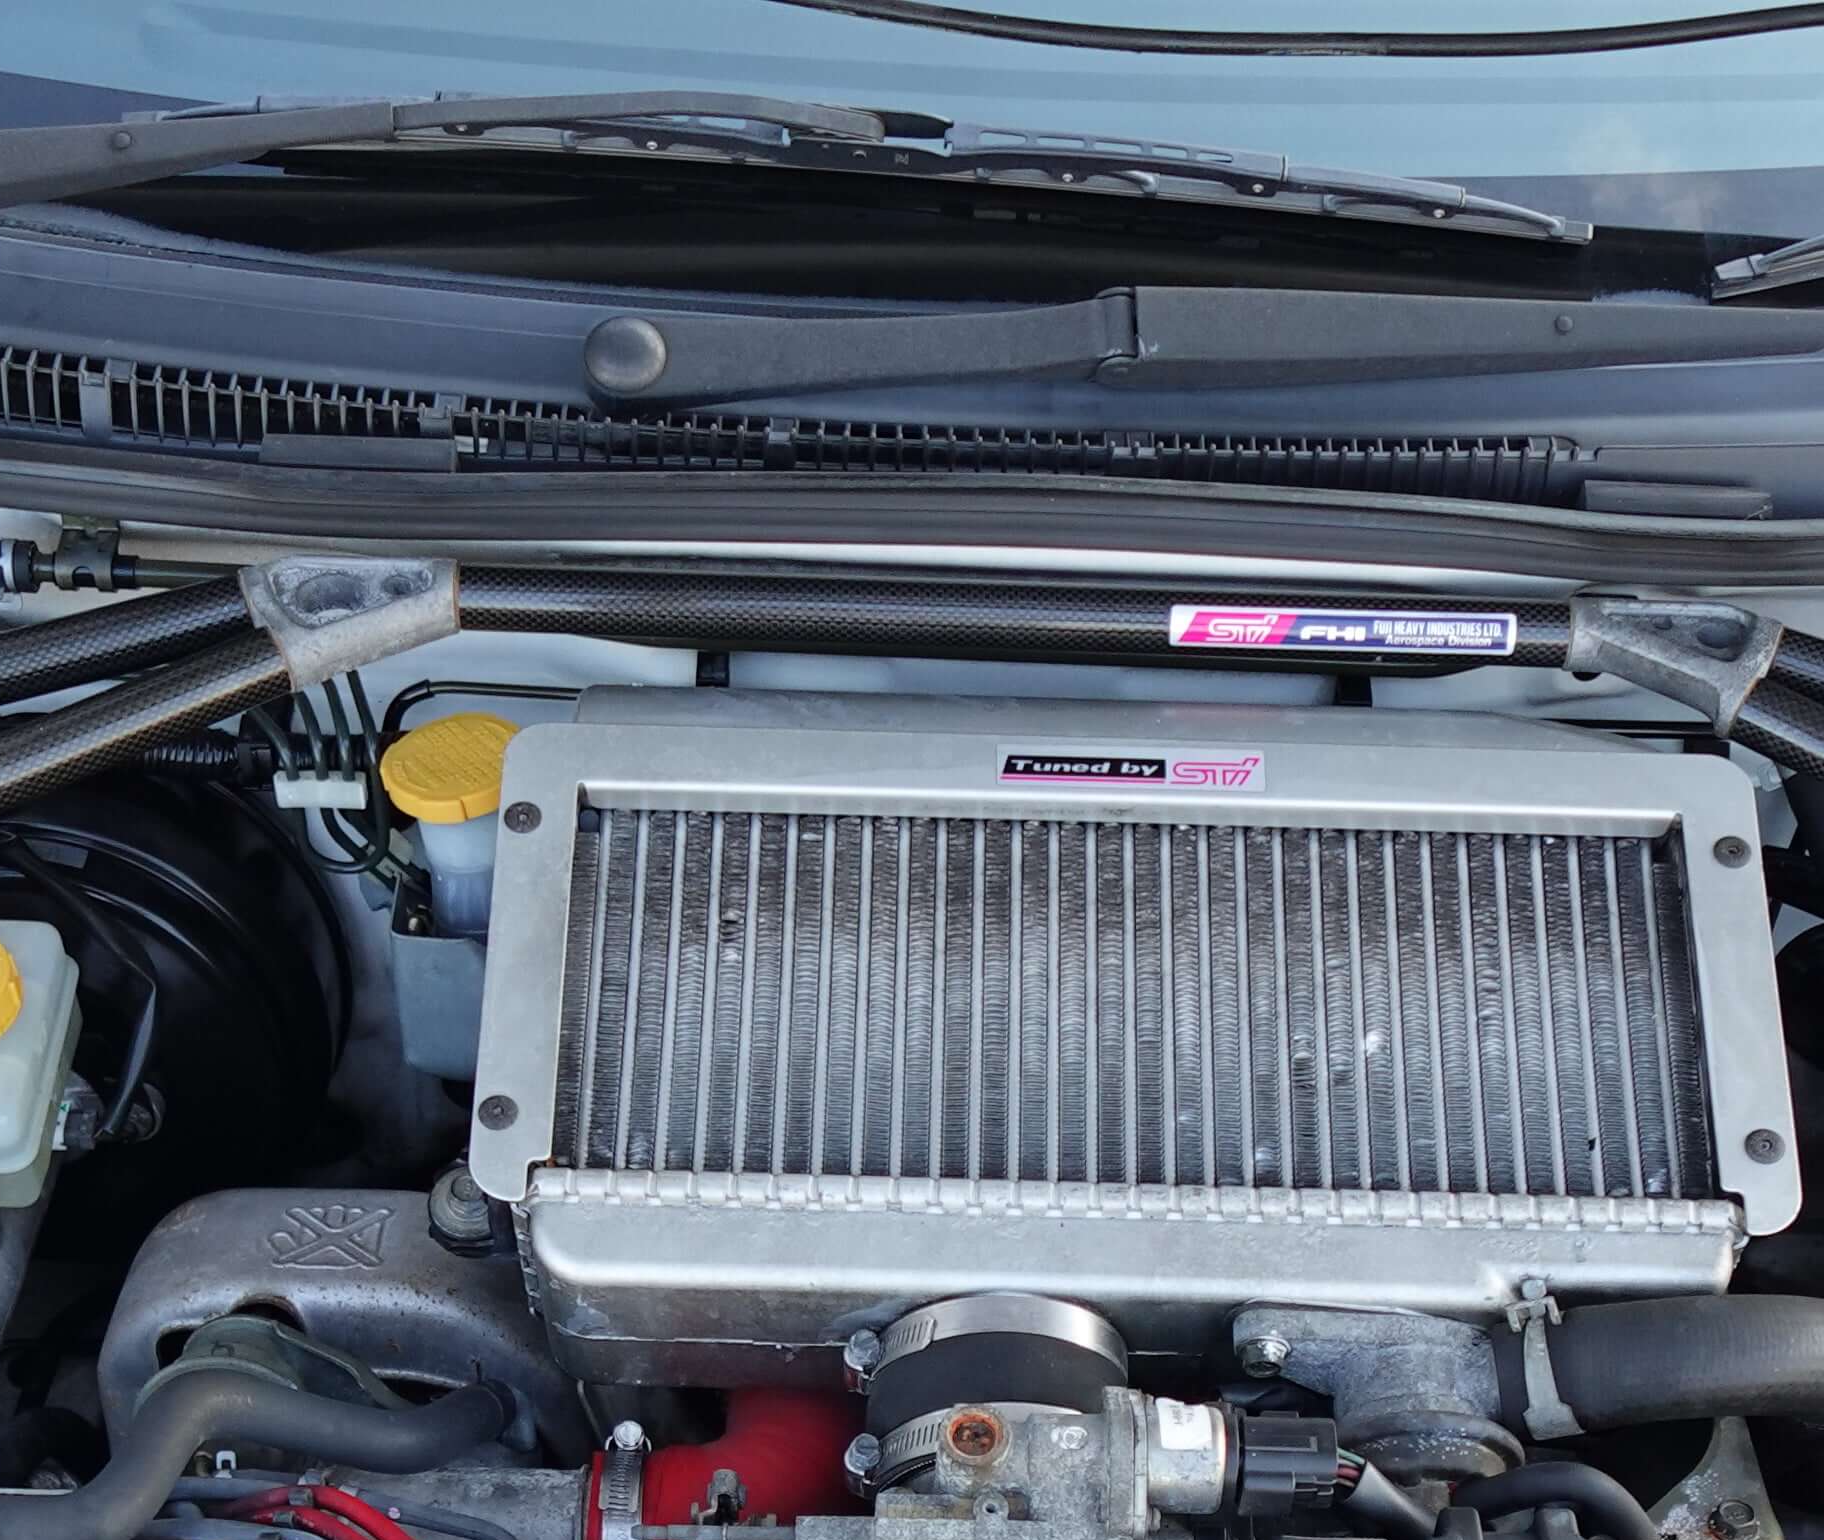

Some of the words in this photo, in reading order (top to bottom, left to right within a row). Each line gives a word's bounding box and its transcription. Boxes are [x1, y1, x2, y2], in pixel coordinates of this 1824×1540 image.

[1300, 624, 1366, 642] FHI
[1373, 619, 1393, 636] FUJI
[1393, 620, 1426, 636] HEAVY
[1427, 621, 1483, 638] INDUSTRIES
[1384, 634, 1445, 648] Aerospace
[1448, 635, 1493, 648] Division
[1010, 758, 1112, 775] Tuned
[1119, 760, 1160, 777] by
